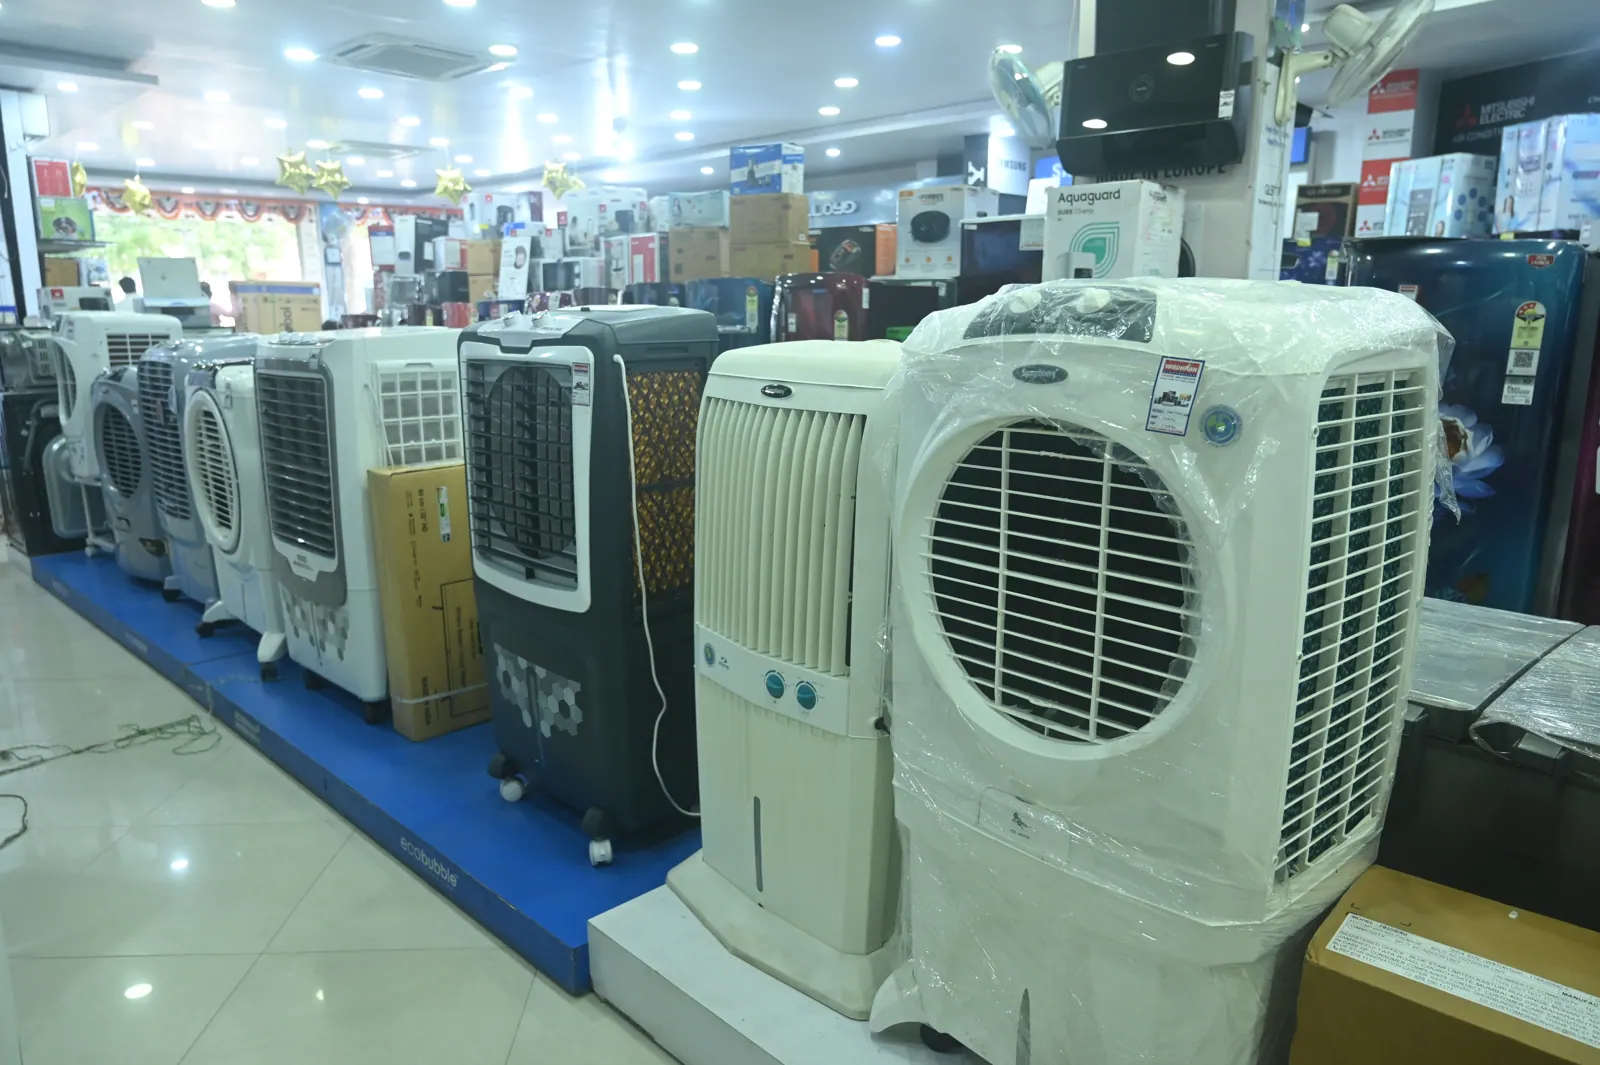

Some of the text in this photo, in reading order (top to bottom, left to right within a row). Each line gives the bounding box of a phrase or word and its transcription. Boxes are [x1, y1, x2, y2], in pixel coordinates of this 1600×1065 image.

[1480, 108, 1526, 125] ELECTRIC
[1058, 188, 1120, 206] Aquaguard
[808, 200, 857, 216] LOYD
[1022, 368, 1056, 380] Symphony
[1428, 961, 1445, 969] STAR
[1475, 982, 1507, 996] MUMBAI
[1484, 990, 1523, 1007] CUSTOMER
[1562, 991, 1598, 1007] MANUFAC
